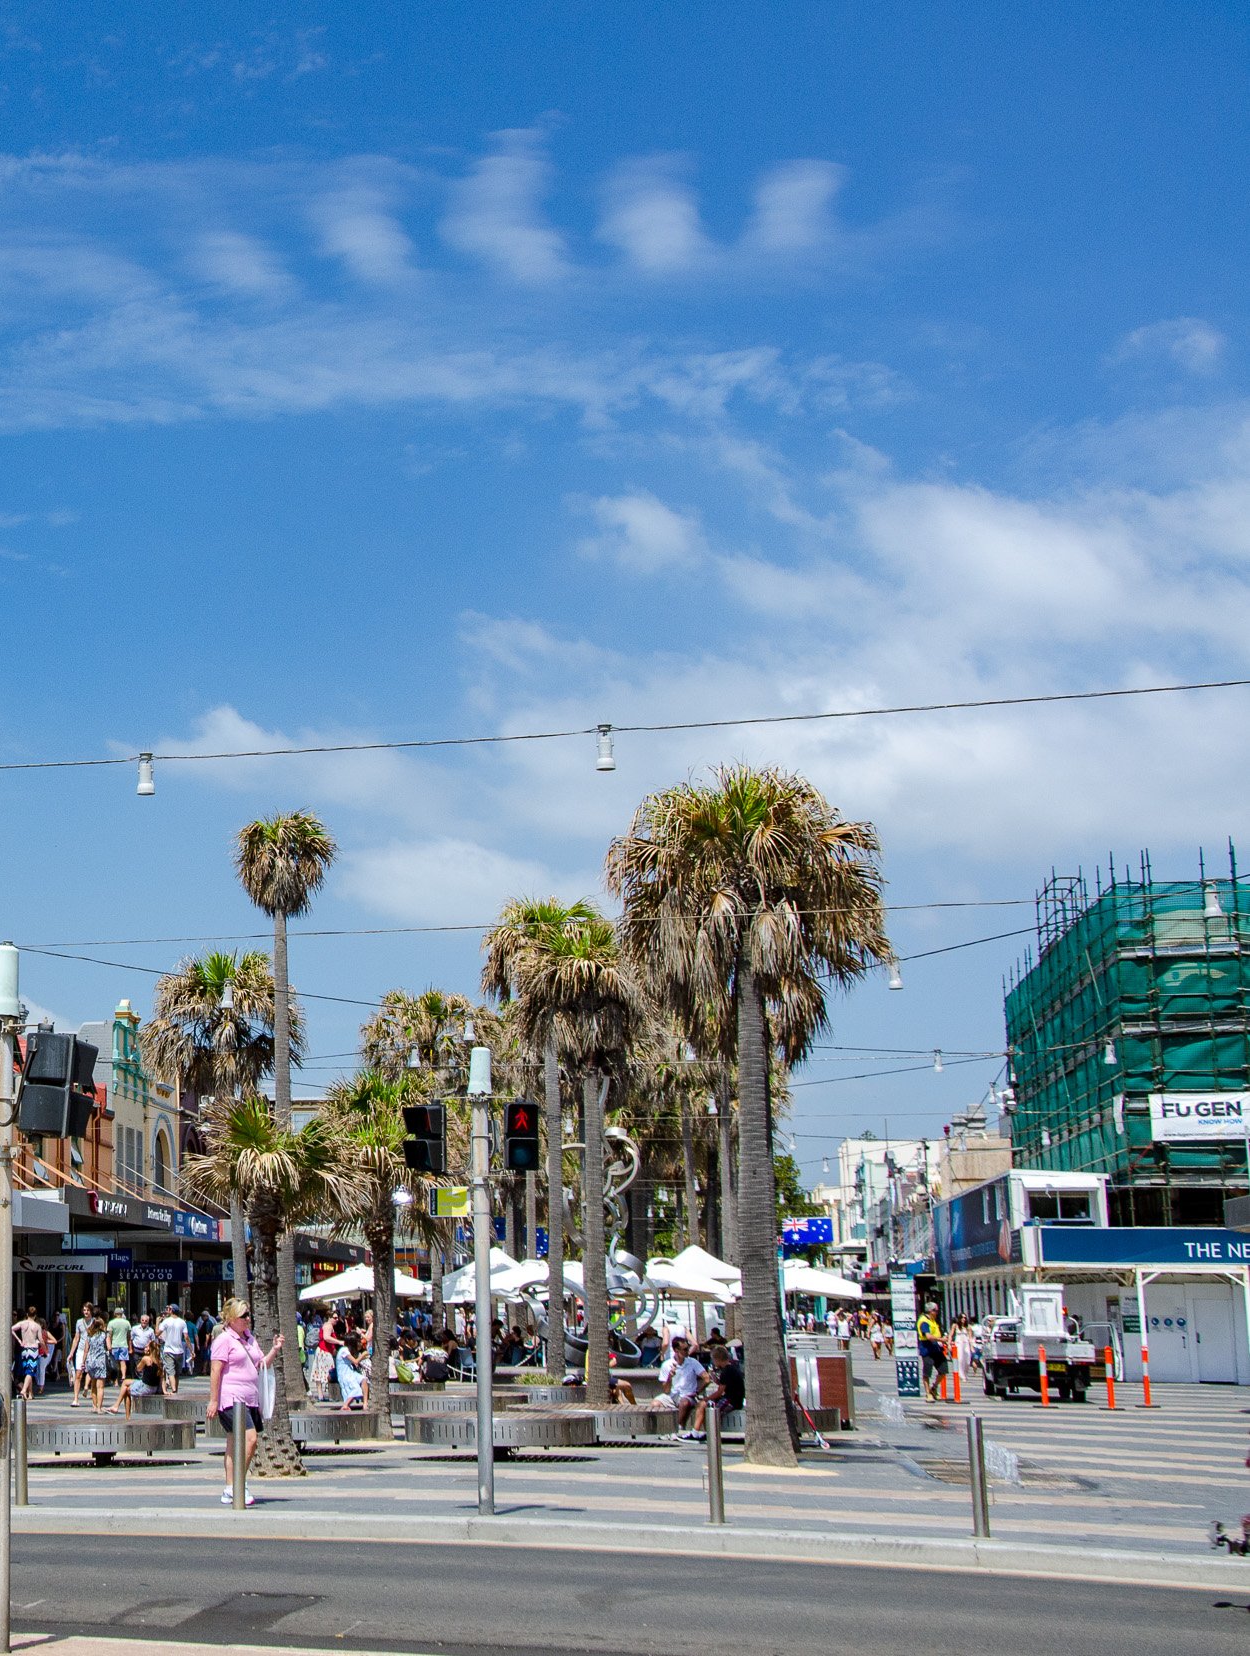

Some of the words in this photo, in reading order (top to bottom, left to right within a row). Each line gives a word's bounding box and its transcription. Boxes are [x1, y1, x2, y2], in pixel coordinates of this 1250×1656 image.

[1195, 1101, 1243, 1117] GEN
[1183, 1242, 1223, 1258] THE
[110, 1253, 130, 1262] Flags
[119, 1272, 173, 1280] SEAFOOD
